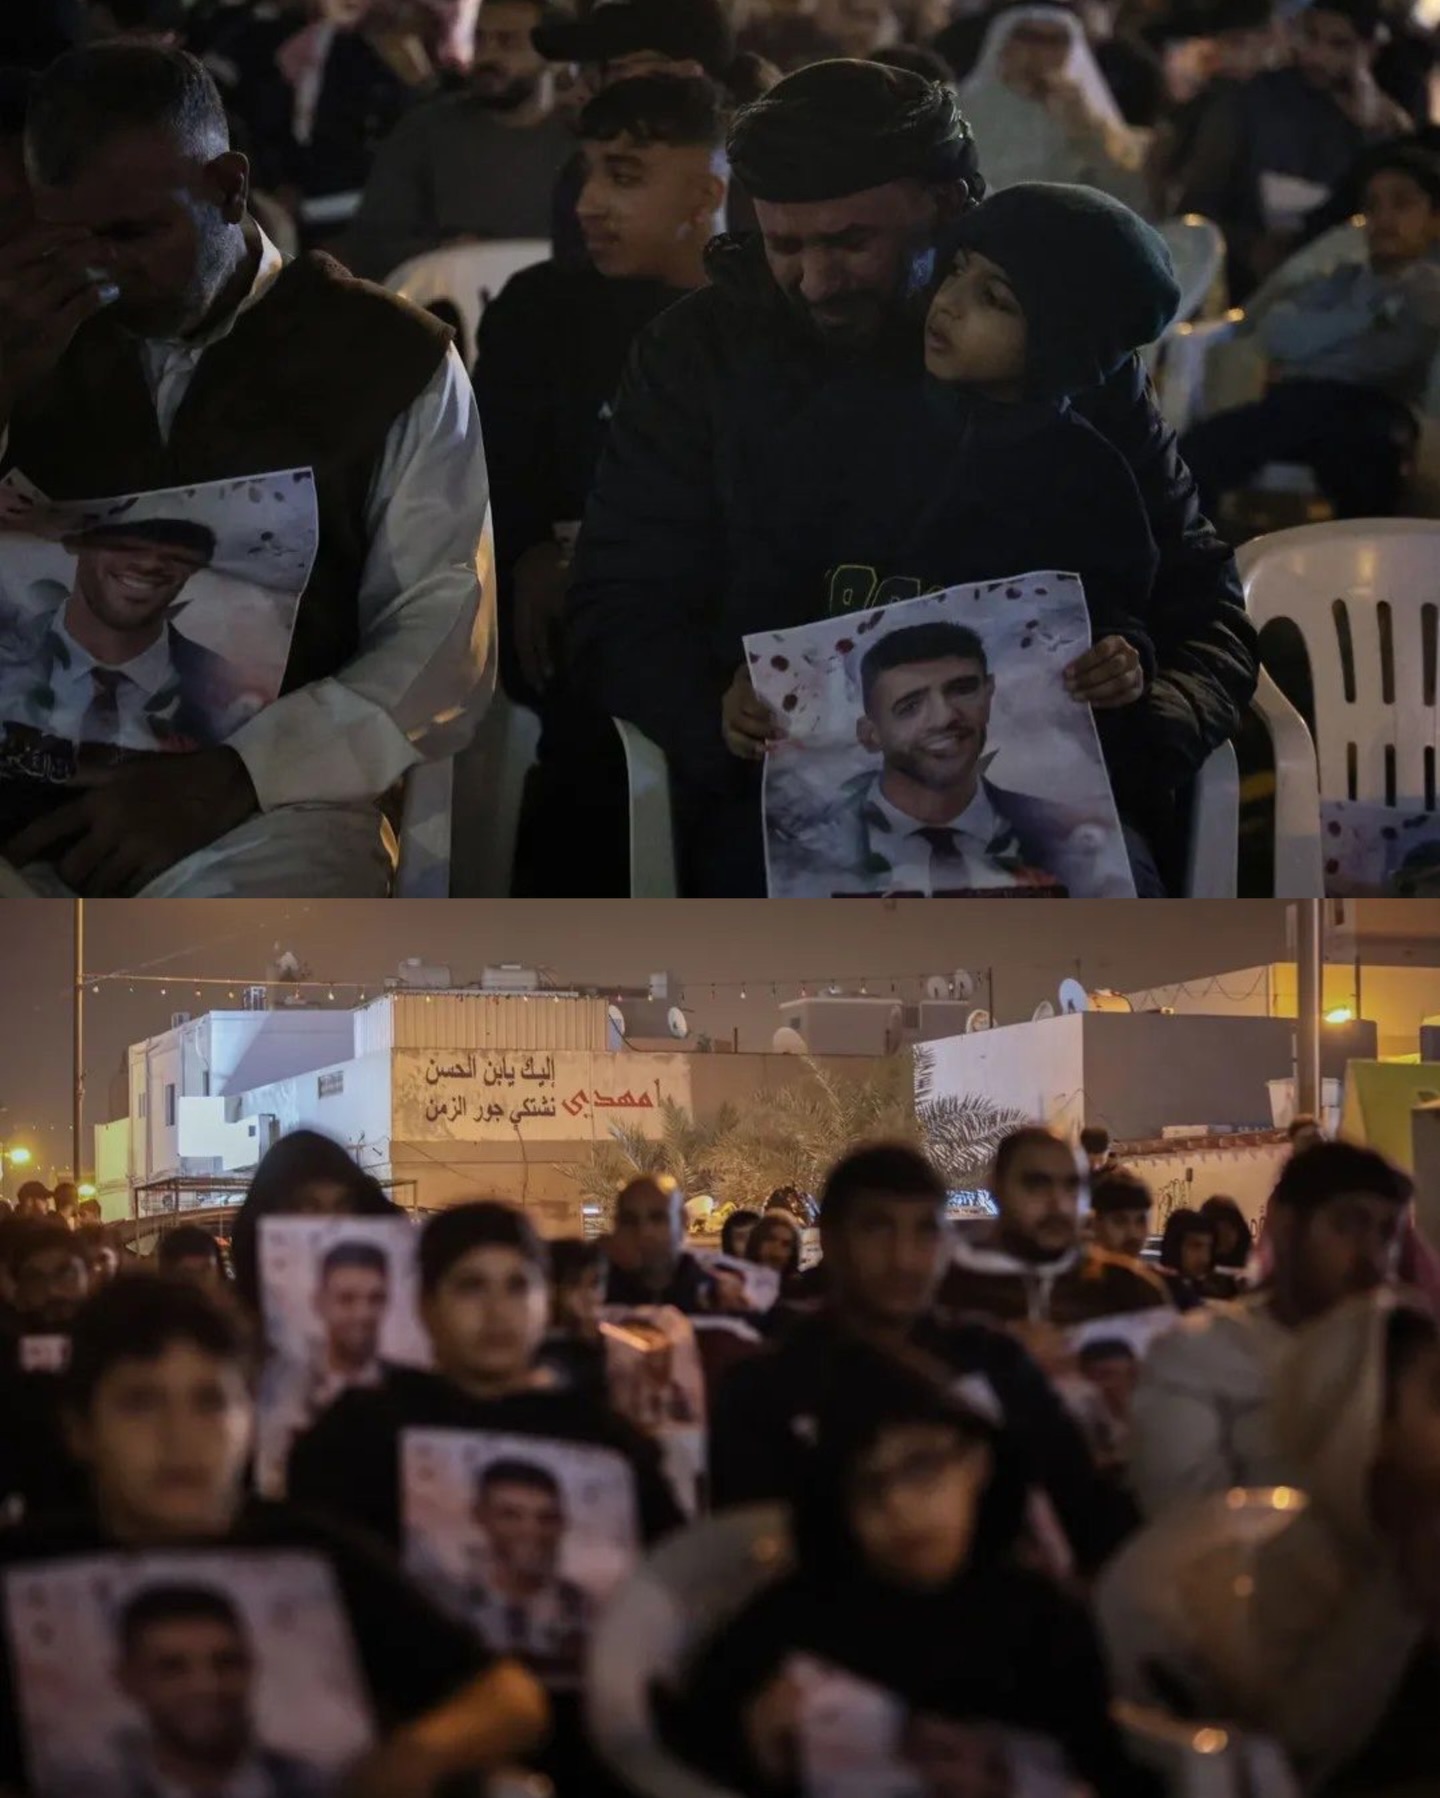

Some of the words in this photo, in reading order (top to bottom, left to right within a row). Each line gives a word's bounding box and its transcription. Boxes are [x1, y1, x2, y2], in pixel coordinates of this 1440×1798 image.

[426, 1053, 476, 1085] الحسن
[484, 1055, 514, 1086] يابن
[425, 1095, 466, 1122] الزمن
[473, 1104, 504, 1122] جور
[509, 1096, 556, 1123] نشتكي
